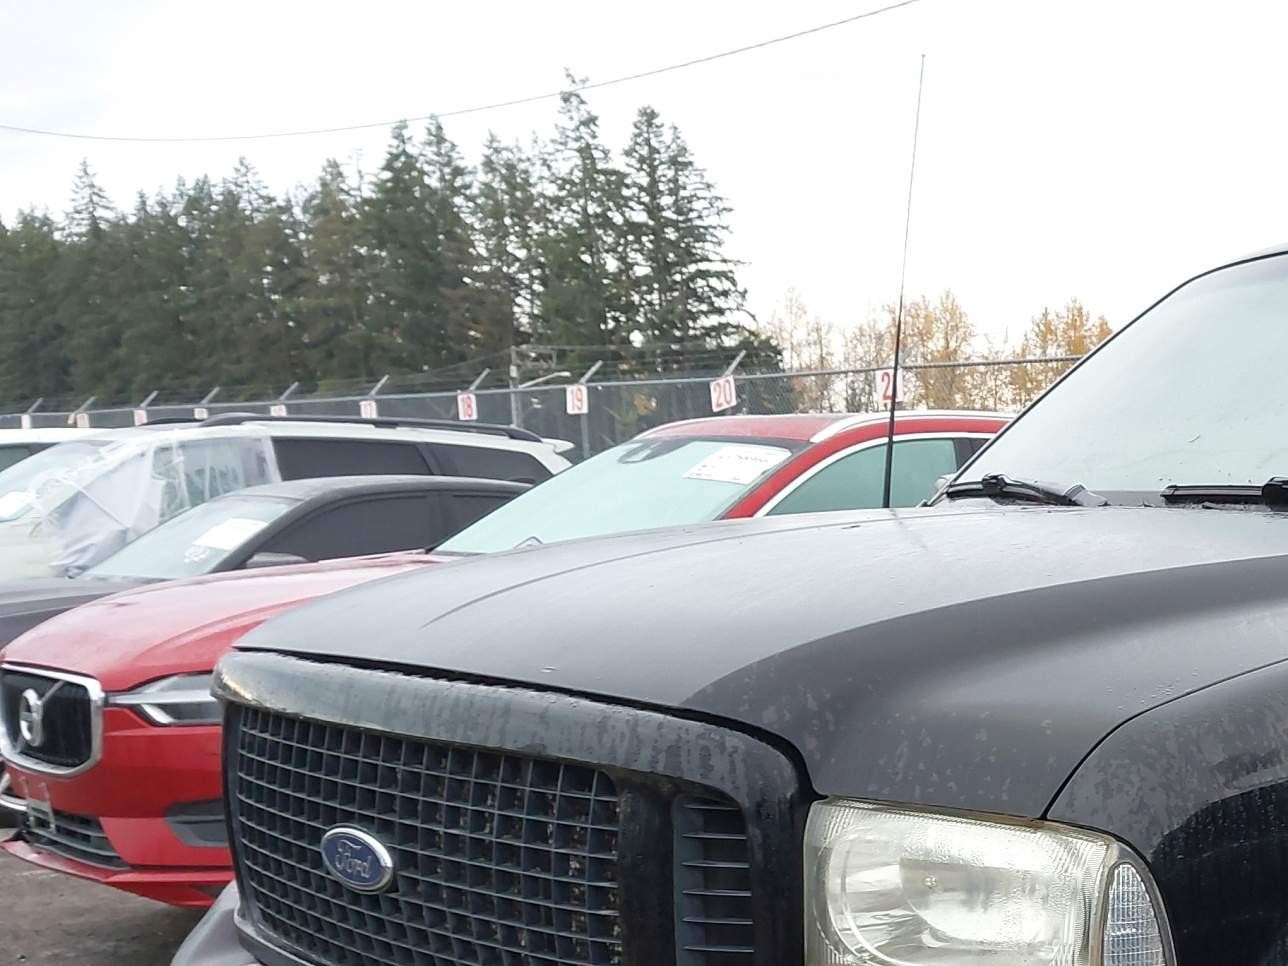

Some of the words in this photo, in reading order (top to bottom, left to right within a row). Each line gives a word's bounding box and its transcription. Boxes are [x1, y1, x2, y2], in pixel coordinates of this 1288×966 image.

[570, 387, 583, 411] 19
[713, 379, 732, 408] 20
[335, 839, 372, 879] Ford
